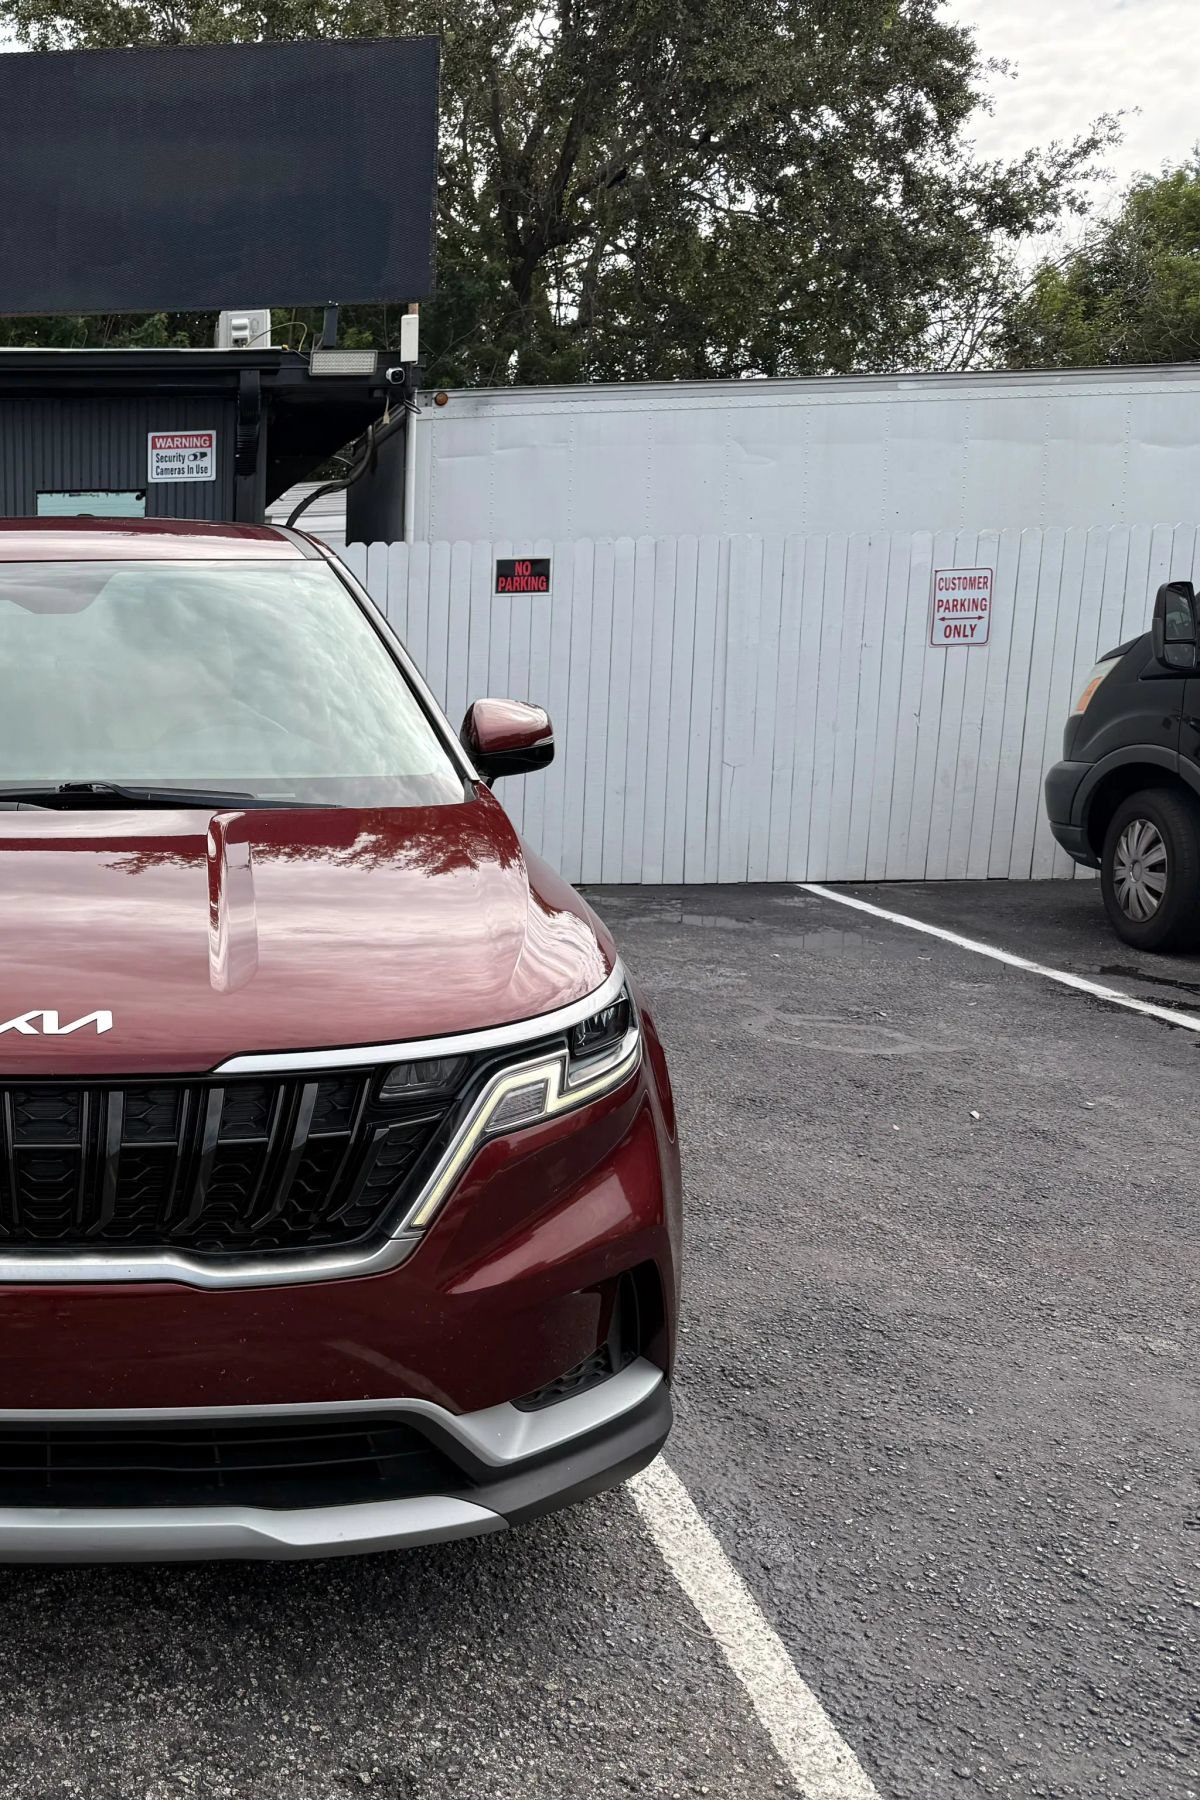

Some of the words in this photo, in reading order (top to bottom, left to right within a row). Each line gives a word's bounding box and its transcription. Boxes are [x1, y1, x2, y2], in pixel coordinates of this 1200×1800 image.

[155, 437, 209, 449] WARNING
[156, 453, 186, 464] Security
[156, 466, 185, 476] Cameras
[187, 465, 194, 475] In
[196, 464, 209, 474] Use
[515, 561, 532, 575] NO
[498, 576, 547, 591] PARKING
[938, 576, 989, 591] CUSTOMER
[937, 598, 987, 613] PARKING
[944, 624, 977, 638] ONLY
